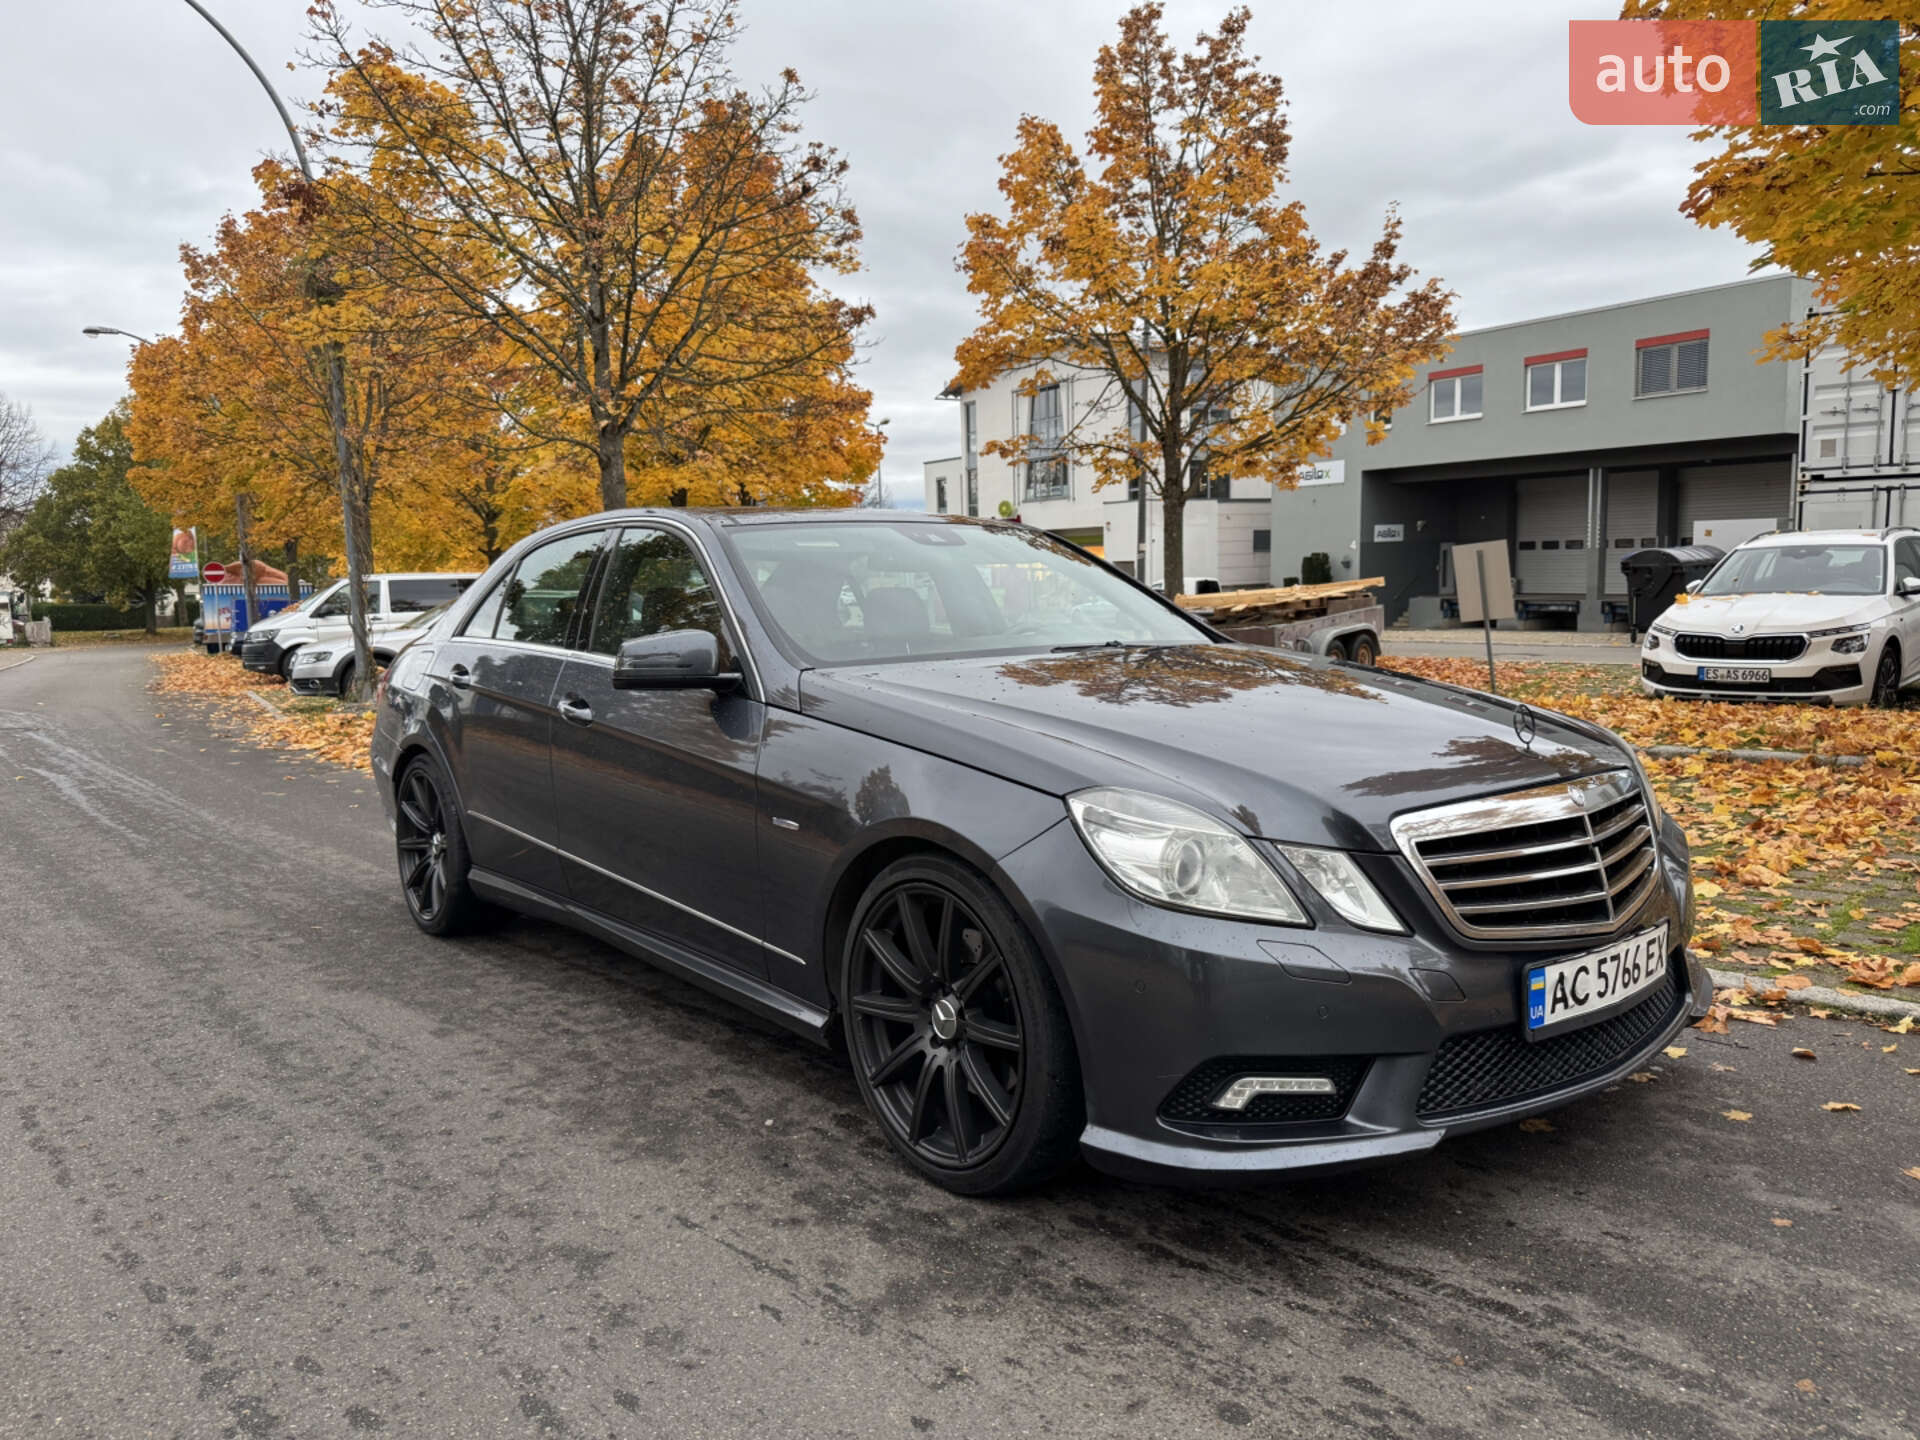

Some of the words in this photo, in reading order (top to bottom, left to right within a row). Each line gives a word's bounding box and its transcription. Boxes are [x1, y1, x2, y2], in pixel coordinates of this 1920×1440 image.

[1706, 669, 1719, 680] ES
[1726, 670, 1739, 681] AS
[1741, 670, 1768, 681] 6966
[1550, 965, 1590, 1015] AC
[1597, 944, 1641, 998] 5766
[1645, 931, 1666, 978] EX
[1530, 1005, 1544, 1019] UA
